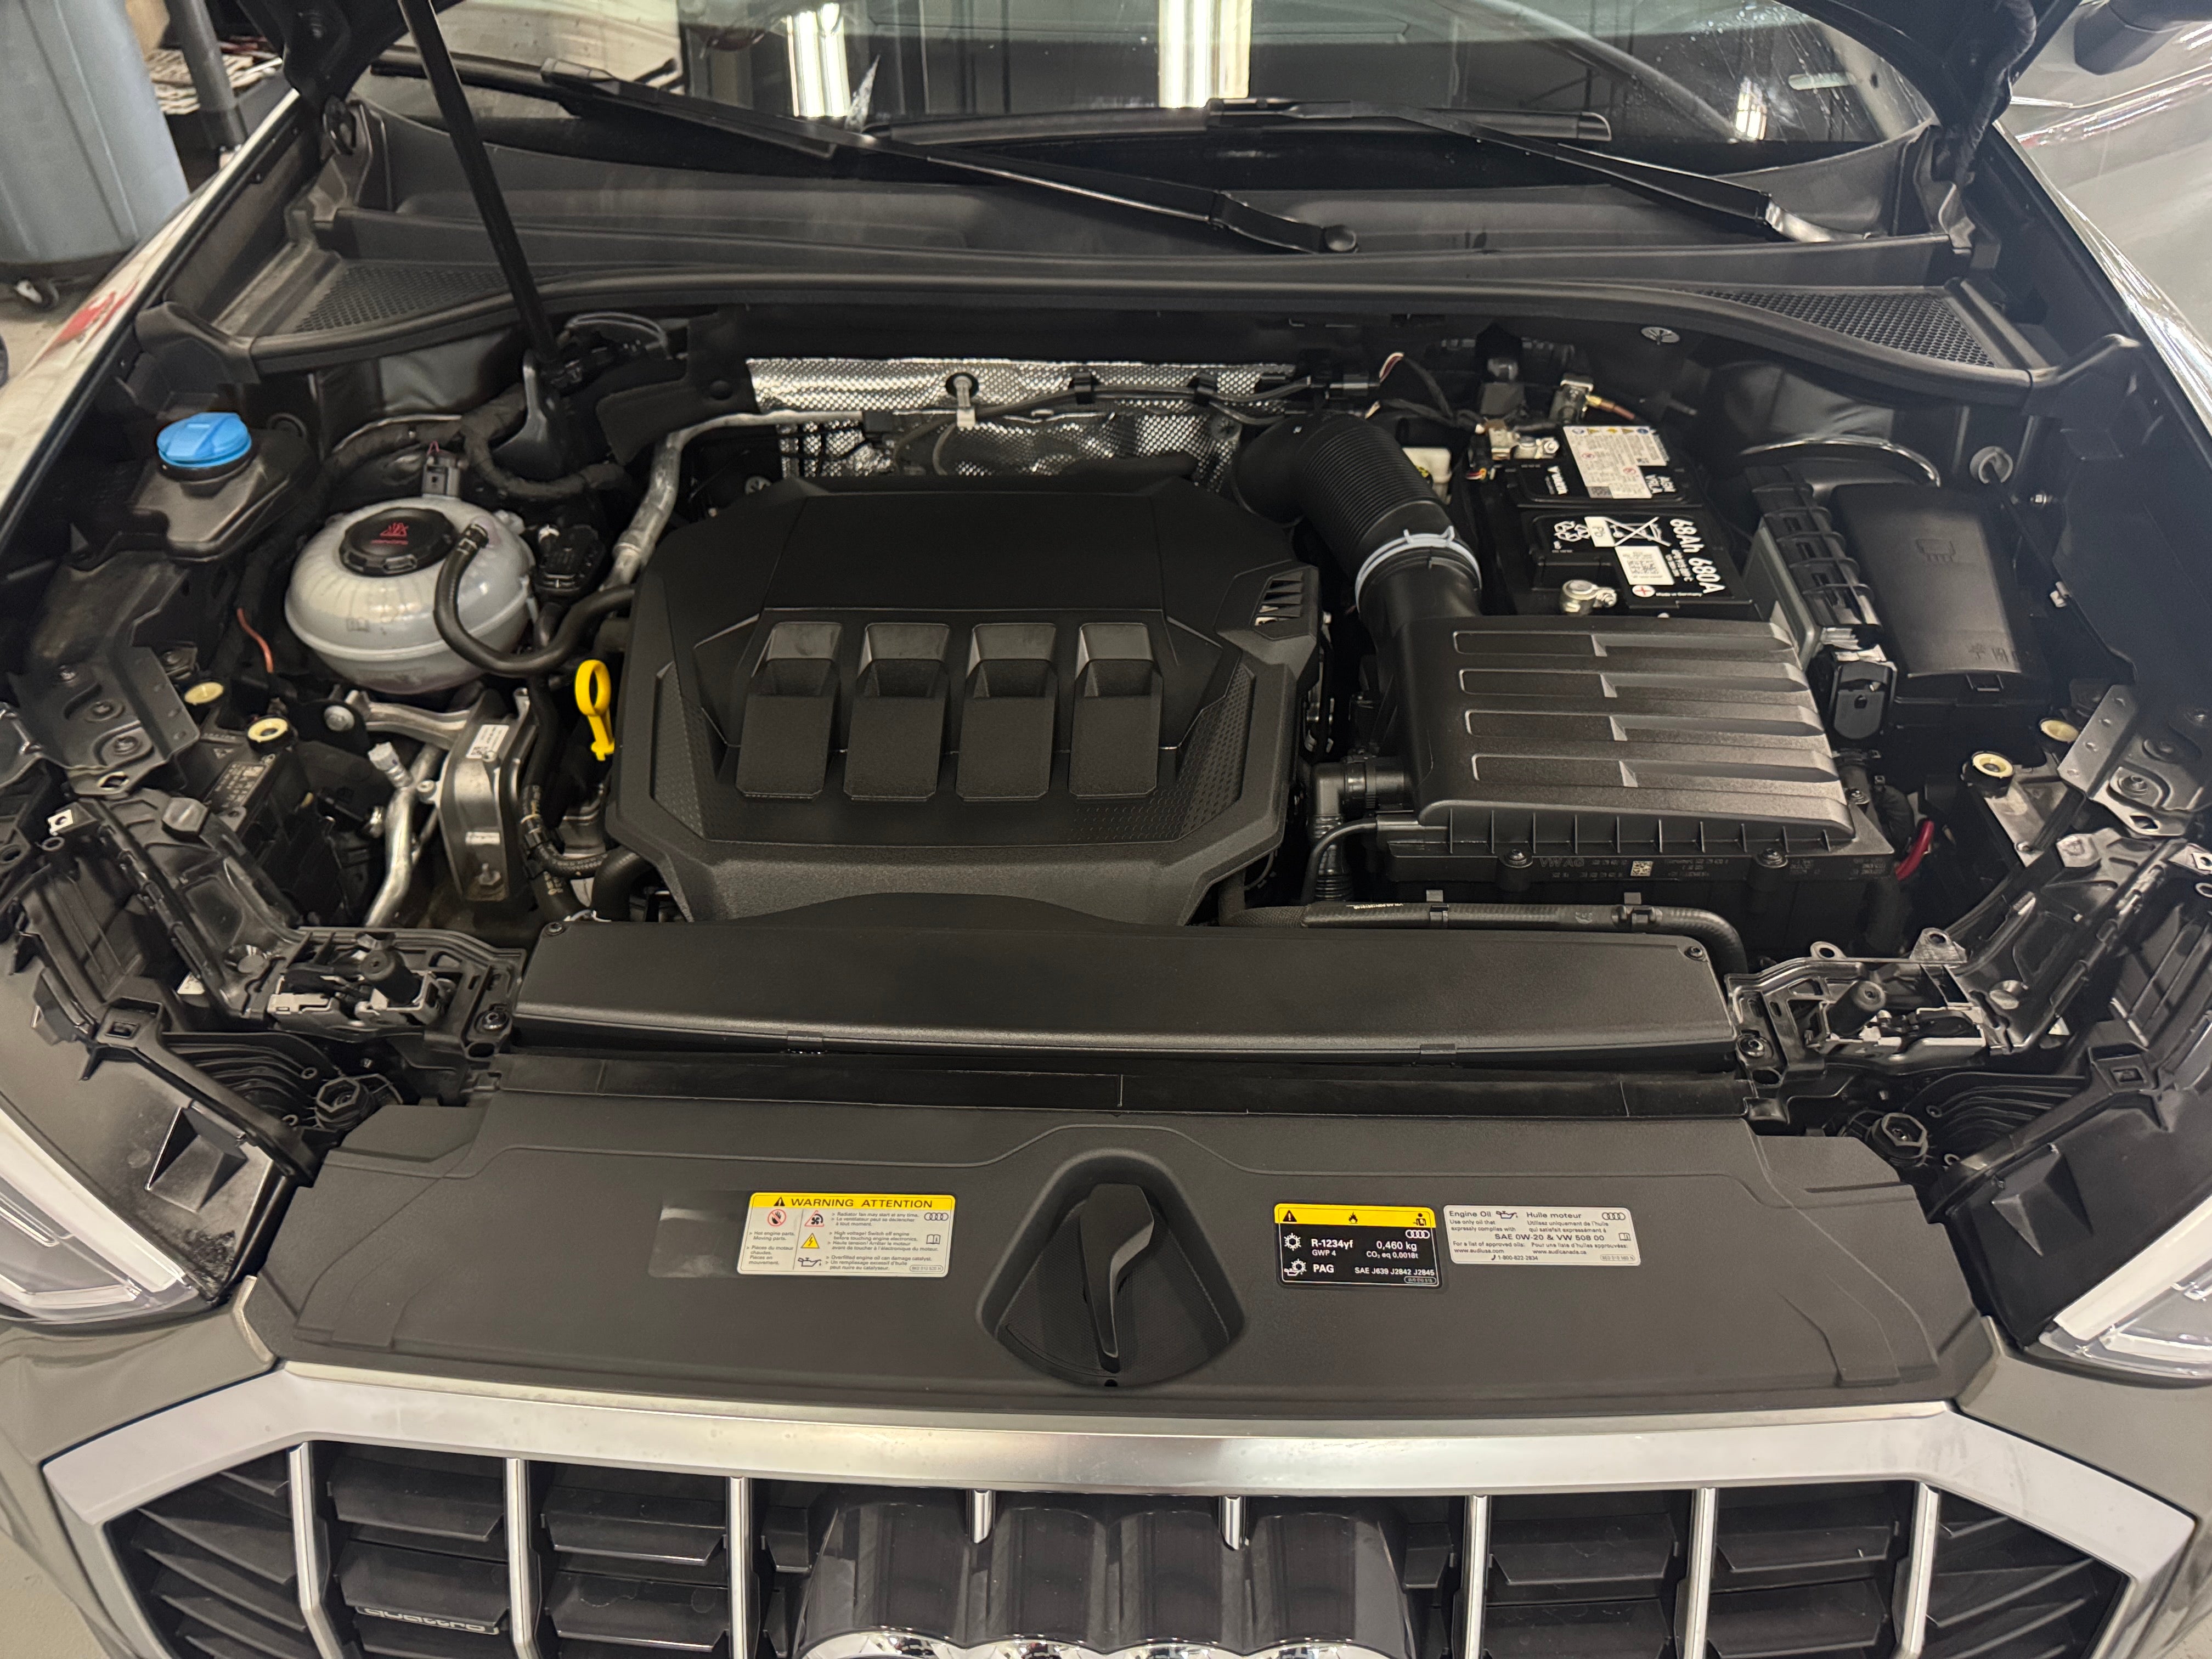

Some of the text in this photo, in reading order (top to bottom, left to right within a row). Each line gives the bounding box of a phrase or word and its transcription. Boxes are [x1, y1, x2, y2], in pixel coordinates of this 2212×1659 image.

[1592, 526, 1605, 537] Pb
[1670, 518, 1705, 552] 68Ah
[1689, 557, 1725, 594] 680A
[792, 1198, 933, 1208] WARNING ATTENTION
[1311, 1239, 1417, 1251] R-1234yf 0,460 kg
[365, 1609, 486, 1632] quattro
